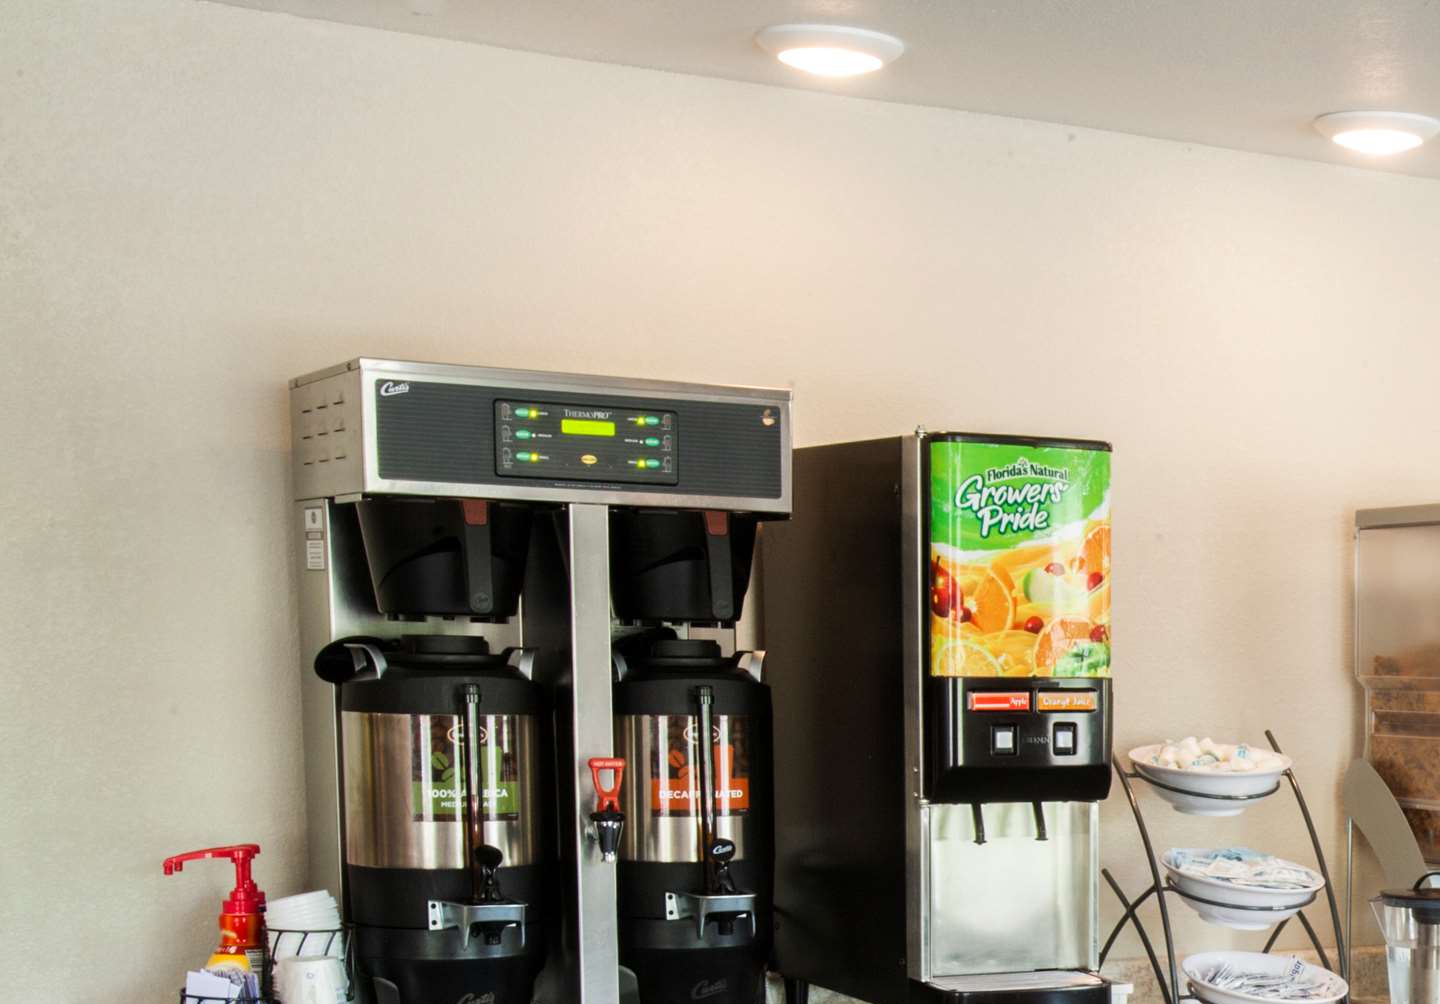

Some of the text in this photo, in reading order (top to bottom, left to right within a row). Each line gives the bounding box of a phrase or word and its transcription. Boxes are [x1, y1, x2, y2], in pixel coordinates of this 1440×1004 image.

[1030, 464, 1068, 480] Natural
[977, 503, 1048, 538] Pride
[1009, 697, 1027, 707] Apple
[427, 788, 458, 799] 00%
